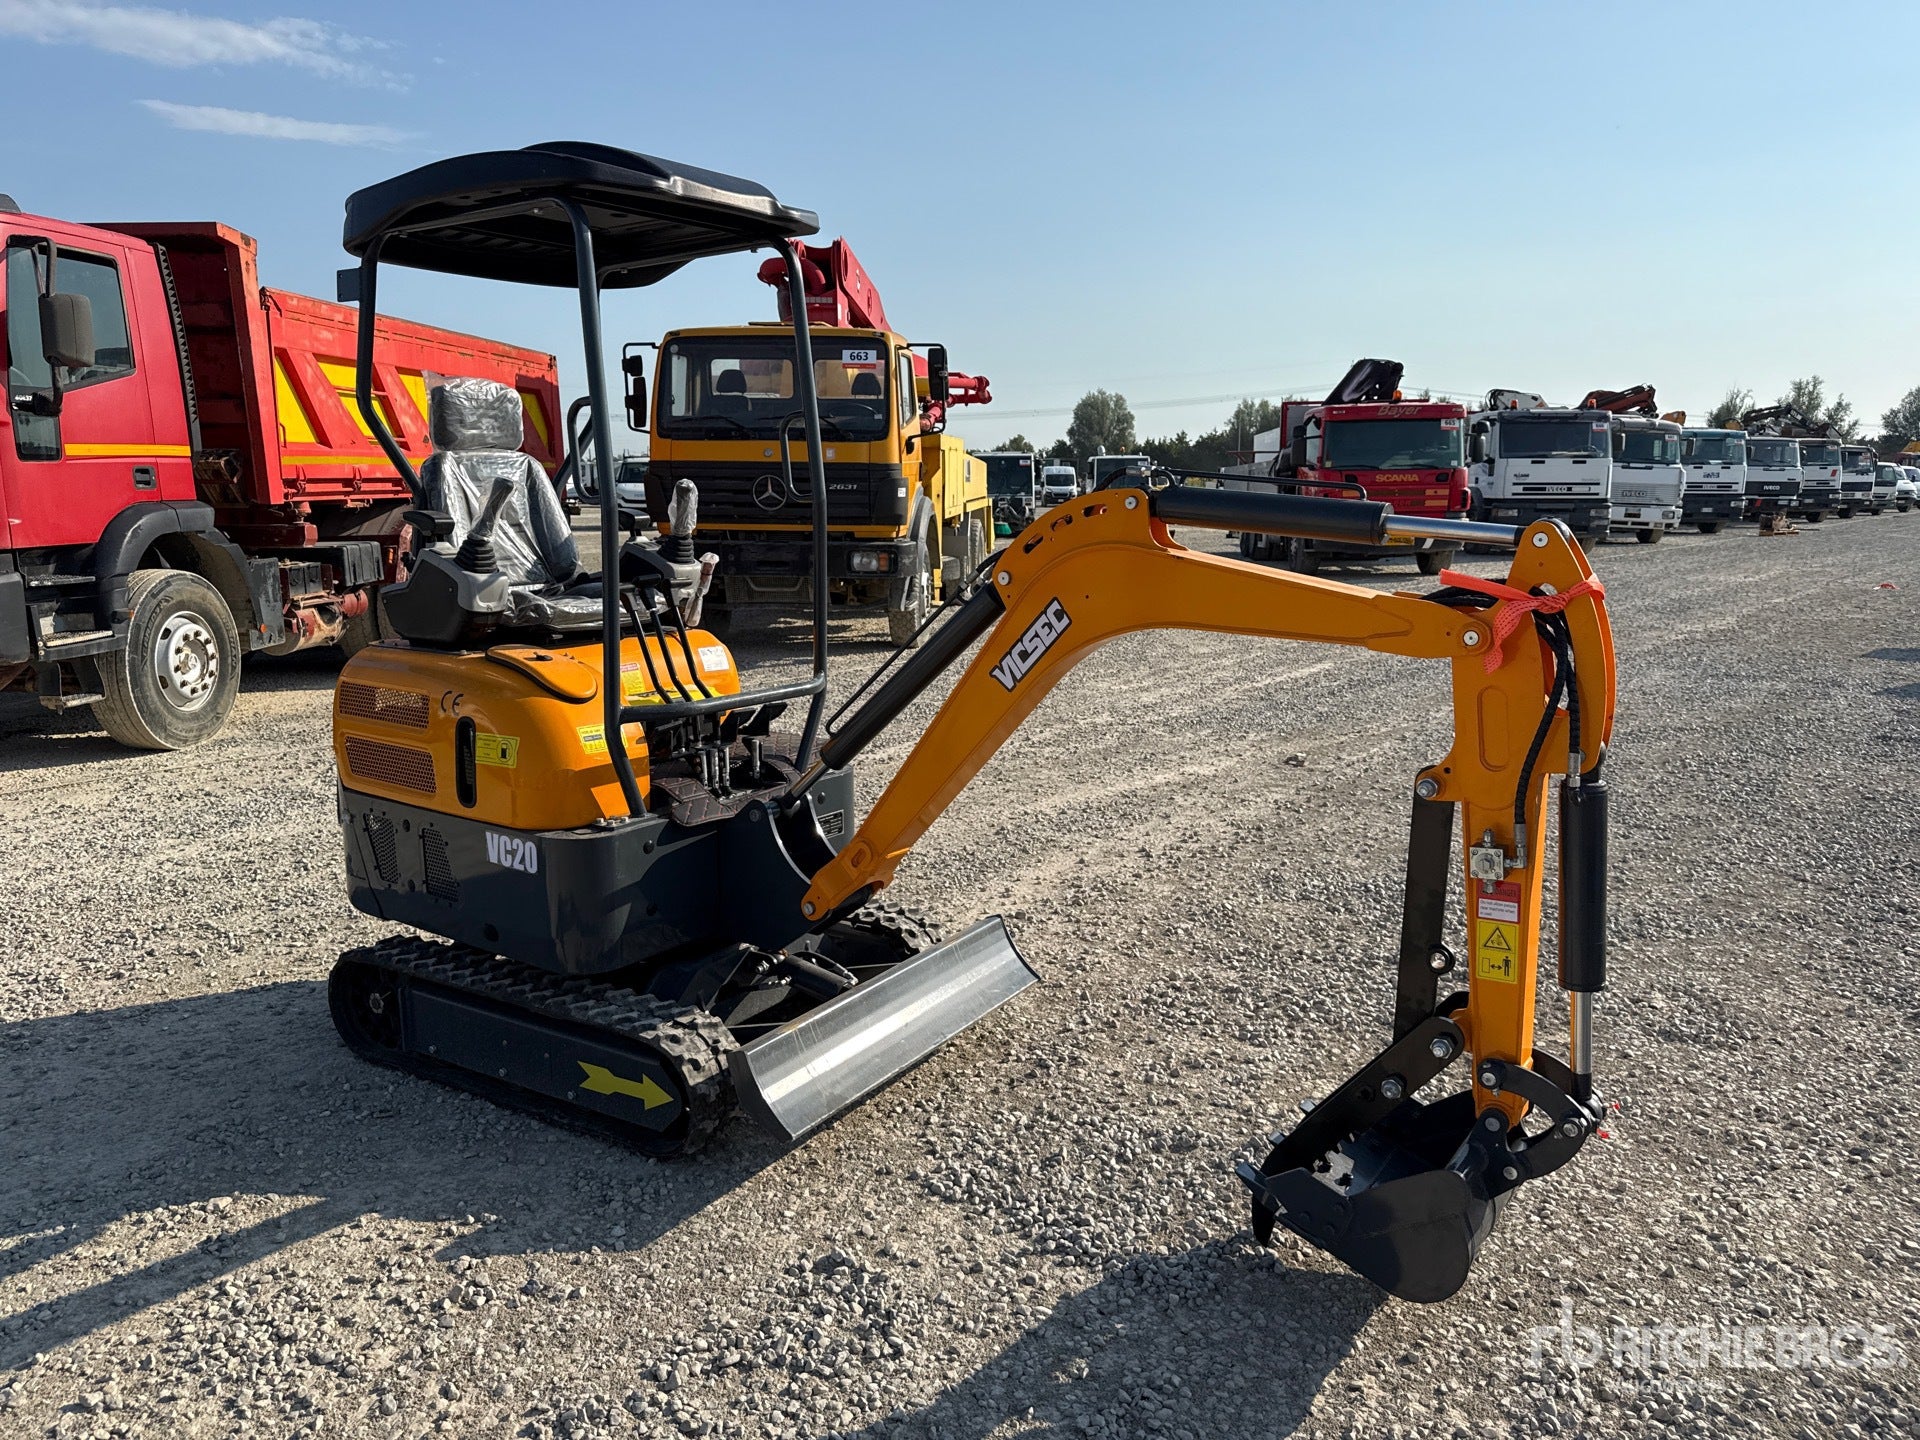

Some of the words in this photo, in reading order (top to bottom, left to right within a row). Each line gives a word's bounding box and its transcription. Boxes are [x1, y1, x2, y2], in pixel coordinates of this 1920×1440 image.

[849, 352, 869, 361] 663
[1378, 405, 1422, 418] Bayer
[1375, 474, 1420, 482] SCANIA
[990, 598, 1071, 691] VICSEC
[485, 831, 538, 874] VC20
